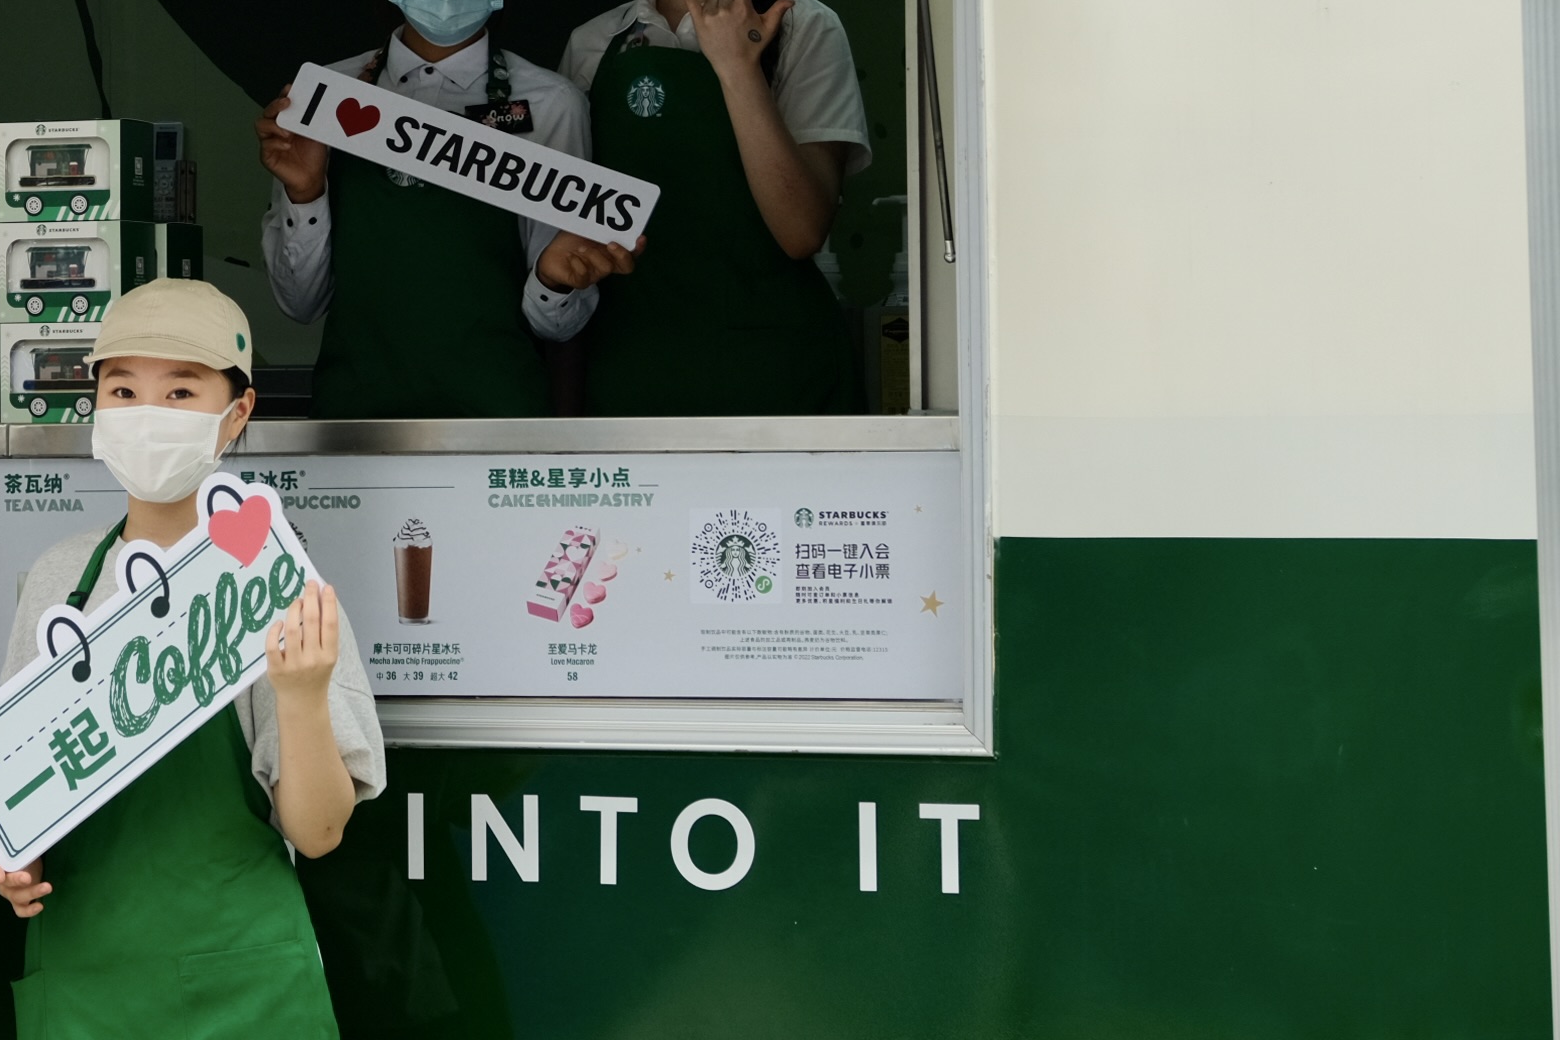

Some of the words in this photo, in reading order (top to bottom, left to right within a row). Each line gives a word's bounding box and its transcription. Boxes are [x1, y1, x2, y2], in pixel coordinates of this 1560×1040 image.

[300, 82, 328, 126] I
[386, 115, 641, 232] STARBUCKS
[488, 467, 631, 489] 蛋糕&星享小点
[4, 499, 84, 512] TEAVANA
[280, 495, 361, 509] PUCCINO
[819, 511, 887, 519] STARBUCKS
[795, 543, 890, 559] 扫码一键入会
[795, 563, 890, 579] 查看电子小票
[373, 643, 461, 655] 摩卡可可碎片星冰乐
[548, 643, 597, 655] 至爱马卡龙
[370, 657, 390, 665] Mocha
[391, 657, 405, 665] Java
[406, 657, 420, 666] Chip
[551, 657, 566, 665] Love
[567, 657, 594, 665] Macaron
[4, 707, 117, 811] 一起
[109, 553, 305, 737] Coffee
[376, 672, 384, 680] 中
[386, 671, 397, 680] 36
[403, 672, 410, 680] 大
[413, 671, 424, 680] 39
[430, 672, 445, 680] 超大
[448, 671, 458, 680] 42
[567, 672, 578, 681] 58
[408, 793, 756, 891] INTO
[858, 802, 980, 894] IT
